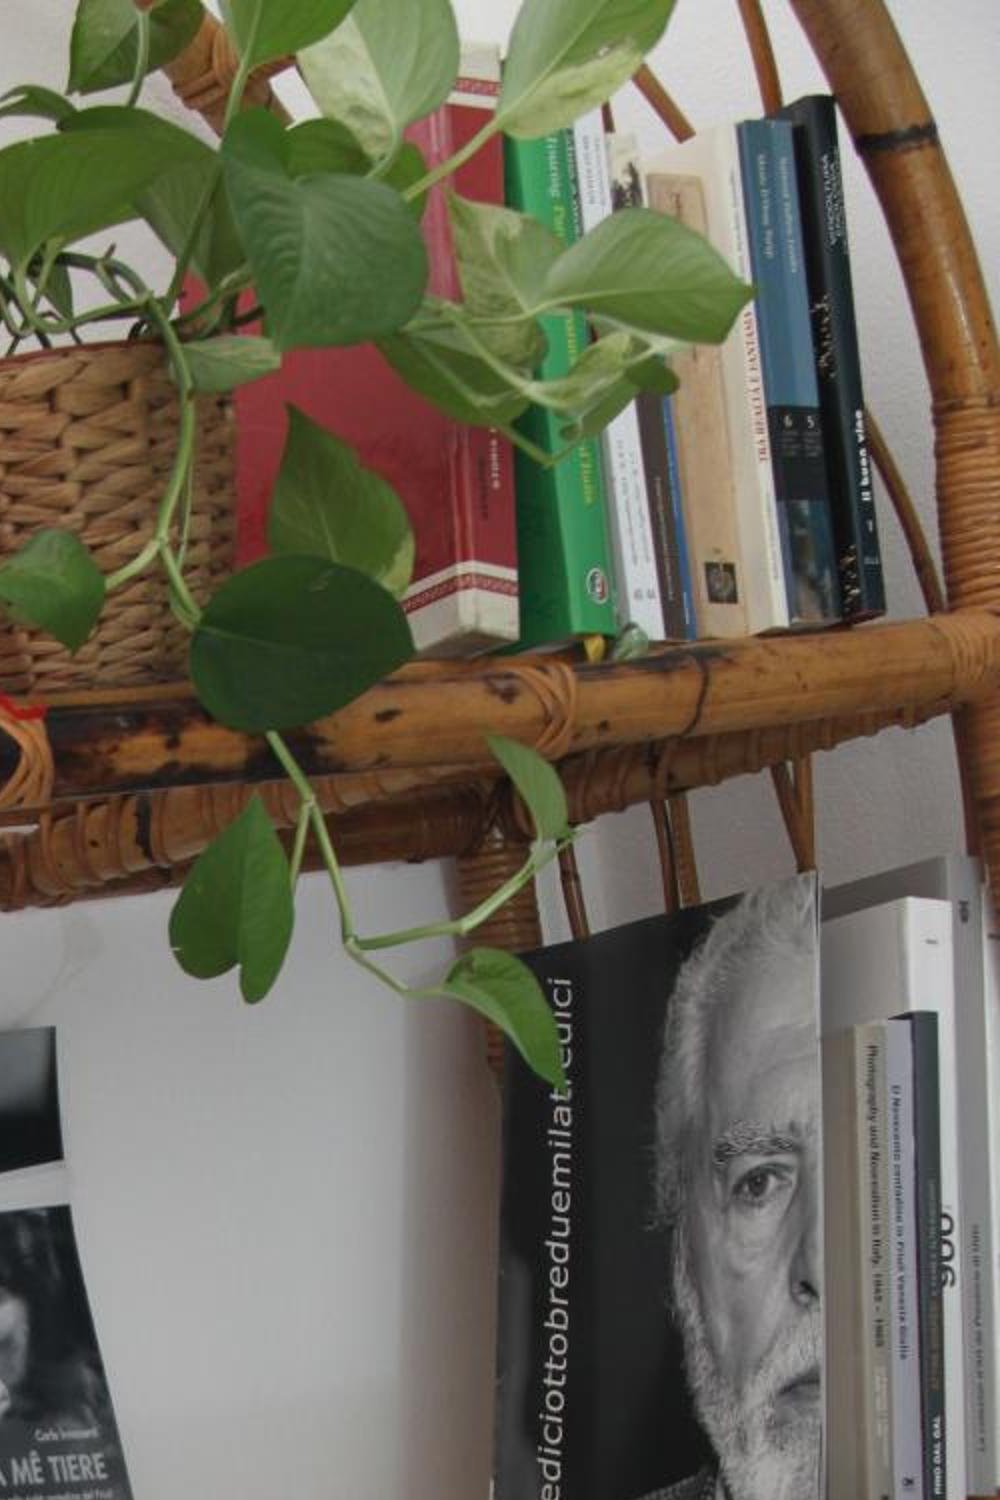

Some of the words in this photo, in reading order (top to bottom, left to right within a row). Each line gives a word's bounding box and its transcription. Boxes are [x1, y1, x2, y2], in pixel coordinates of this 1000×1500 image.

[854, 408, 865, 443] vino
[858, 448, 870, 486] buon
[10, 1449, 45, 1486] MÊ
[47, 1452, 108, 1482] TIERE
